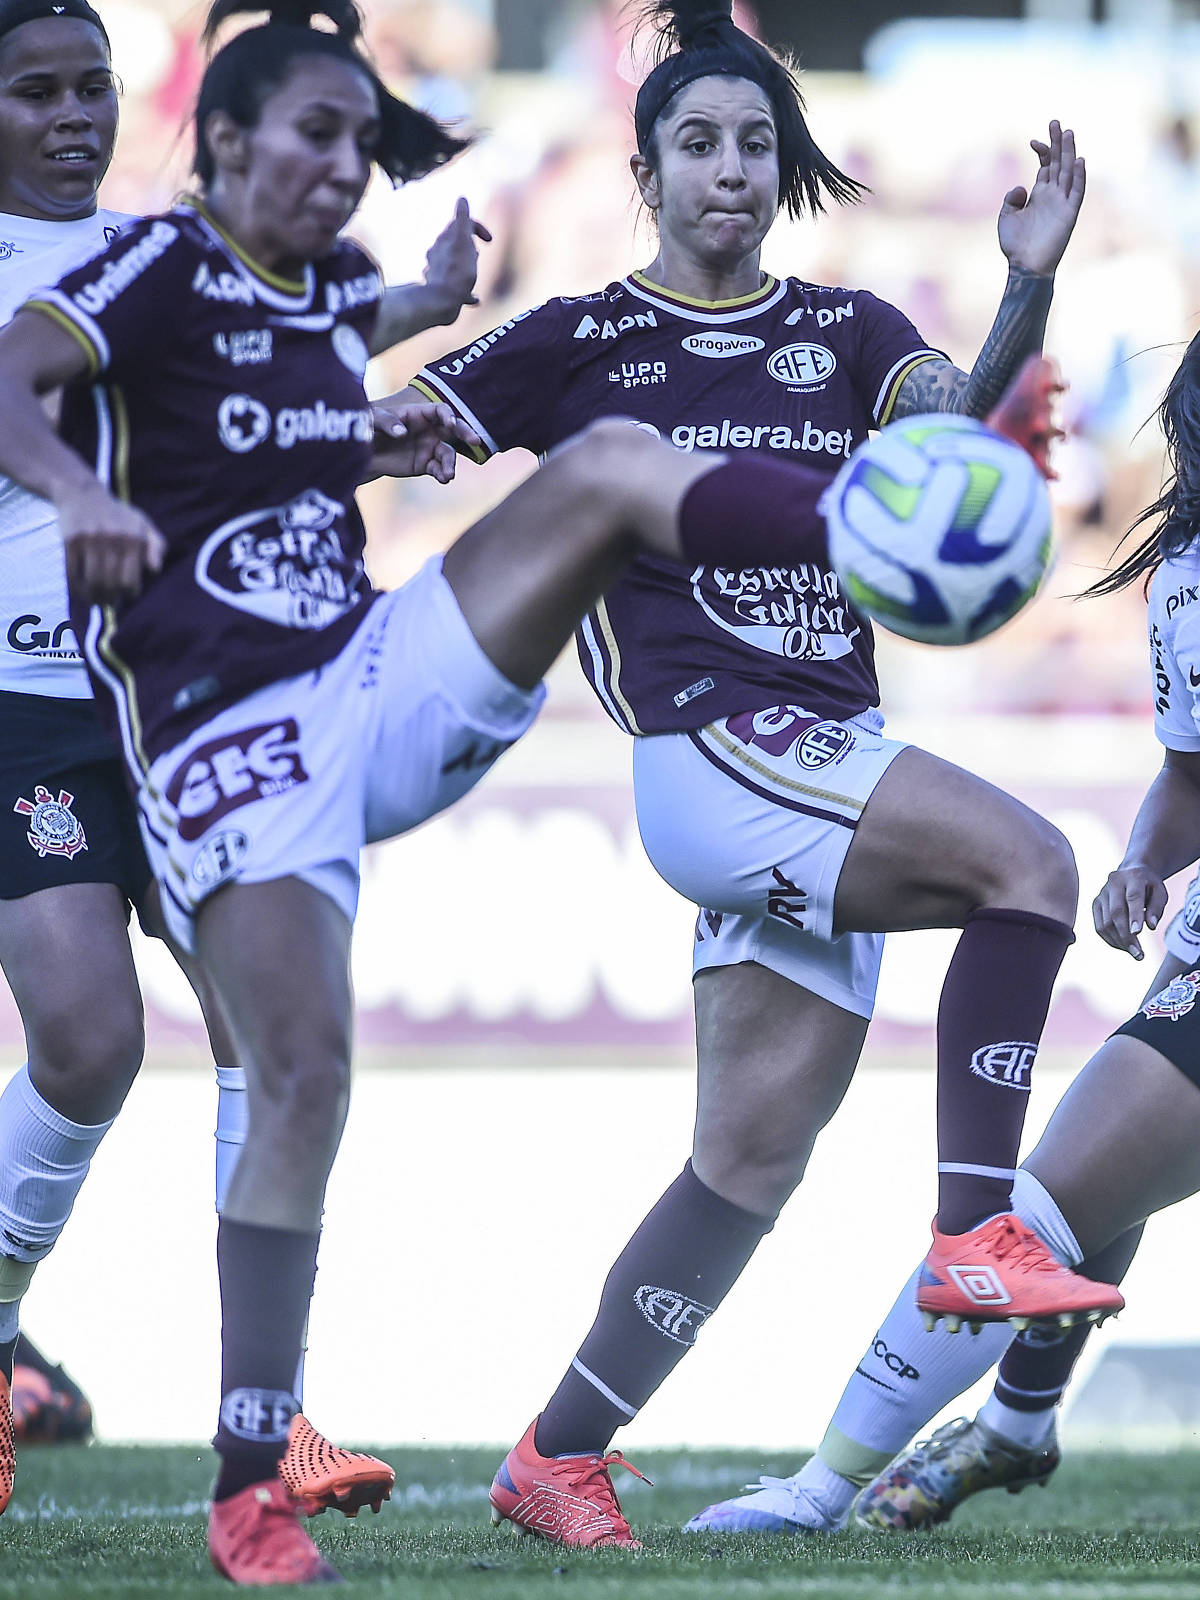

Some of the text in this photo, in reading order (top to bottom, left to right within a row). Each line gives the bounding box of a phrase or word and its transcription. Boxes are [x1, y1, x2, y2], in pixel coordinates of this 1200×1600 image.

[601, 310, 657, 339] ADN
[806, 301, 853, 328] DN
[689, 338, 757, 353] DrogaVen
[623, 374, 667, 388] SPORT
[671, 419, 853, 459] galera.bet
[872, 1339, 920, 1381] CCP
